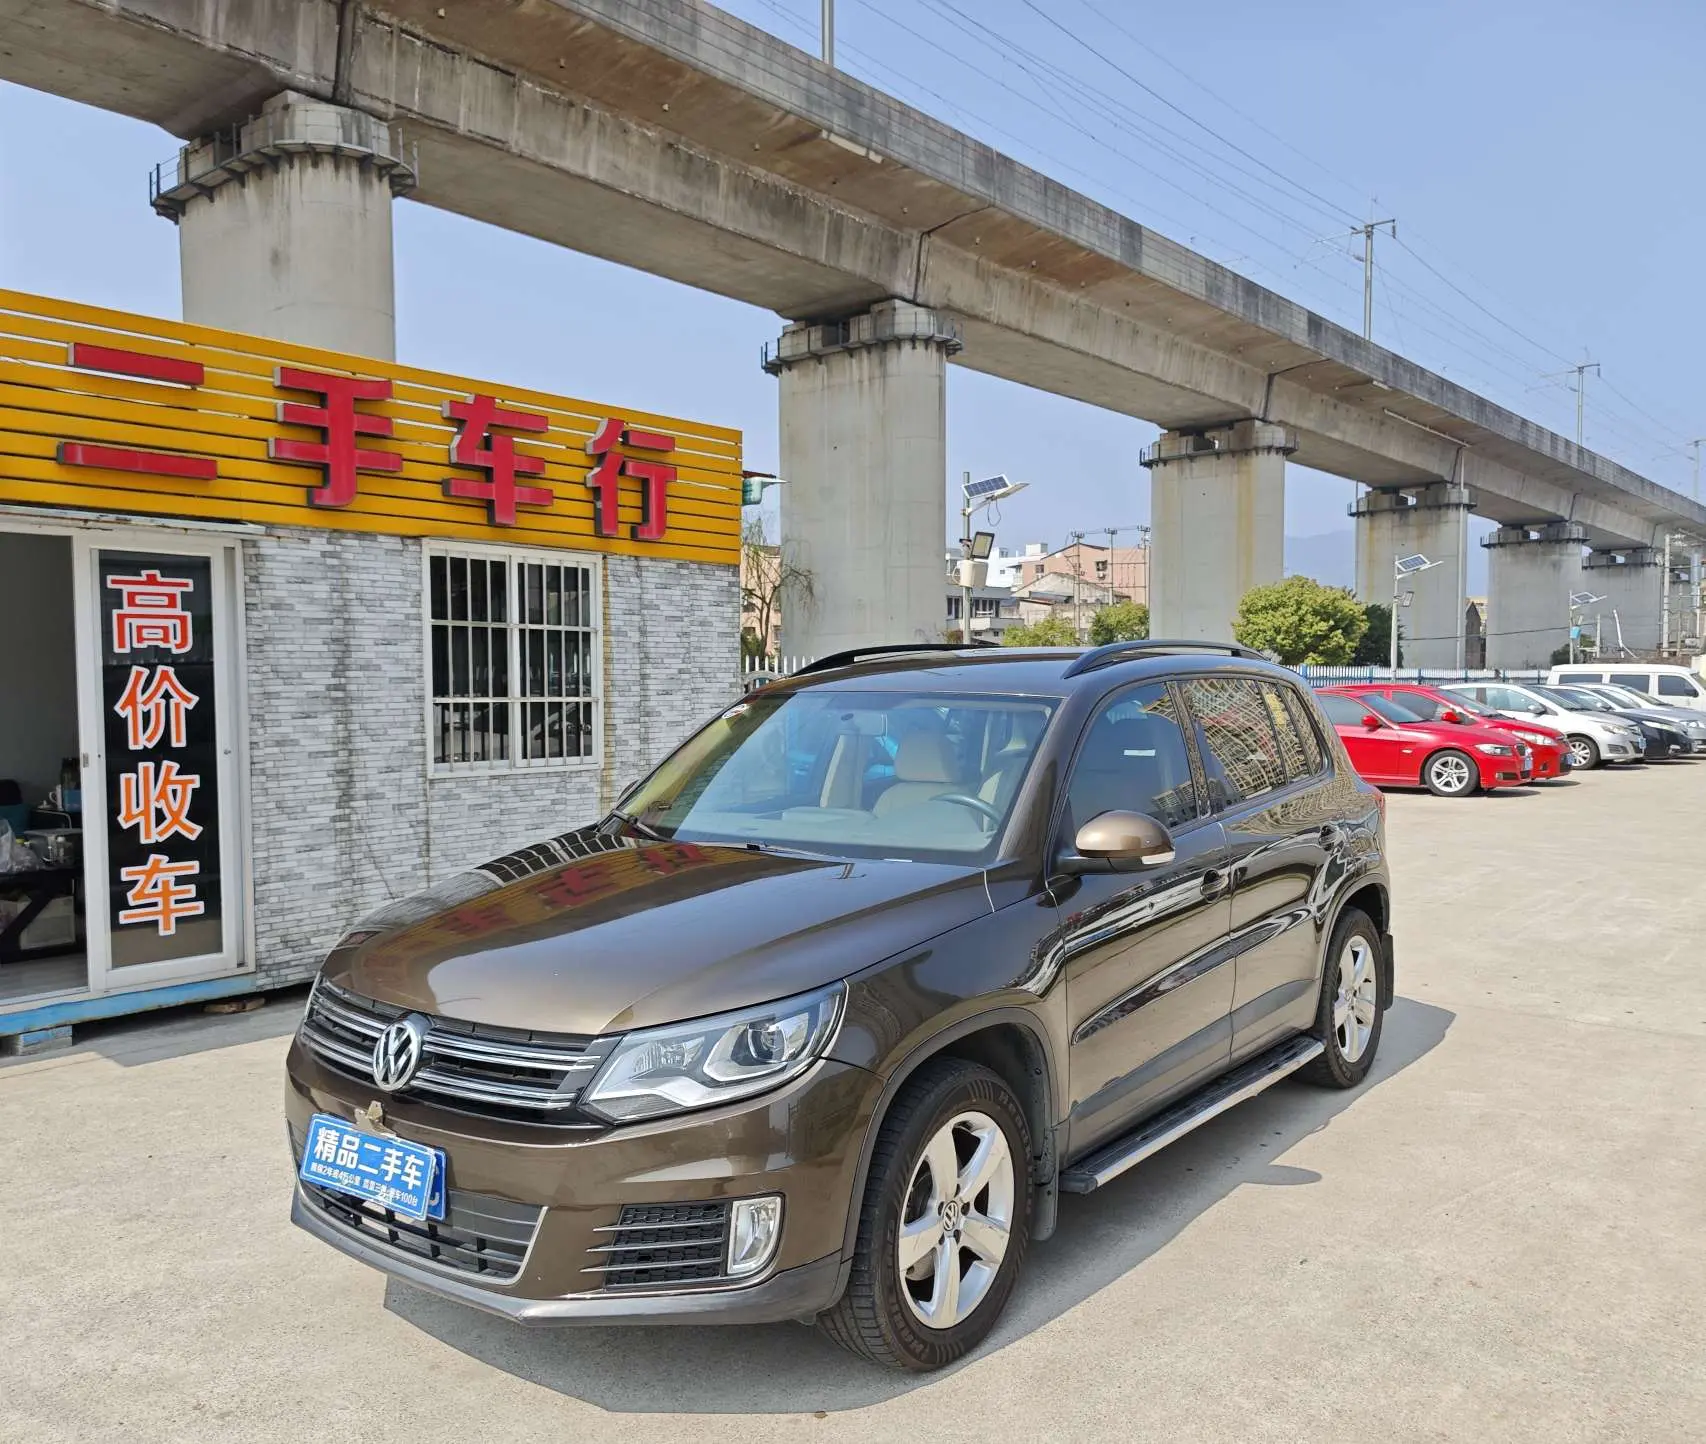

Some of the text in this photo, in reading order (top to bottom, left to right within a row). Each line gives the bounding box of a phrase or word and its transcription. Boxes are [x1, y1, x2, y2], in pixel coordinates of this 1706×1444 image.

[57, 342, 677, 542] 二手车行
[107, 569, 204, 937] 高价收车
[313, 1126, 425, 1191] 精品二手车
